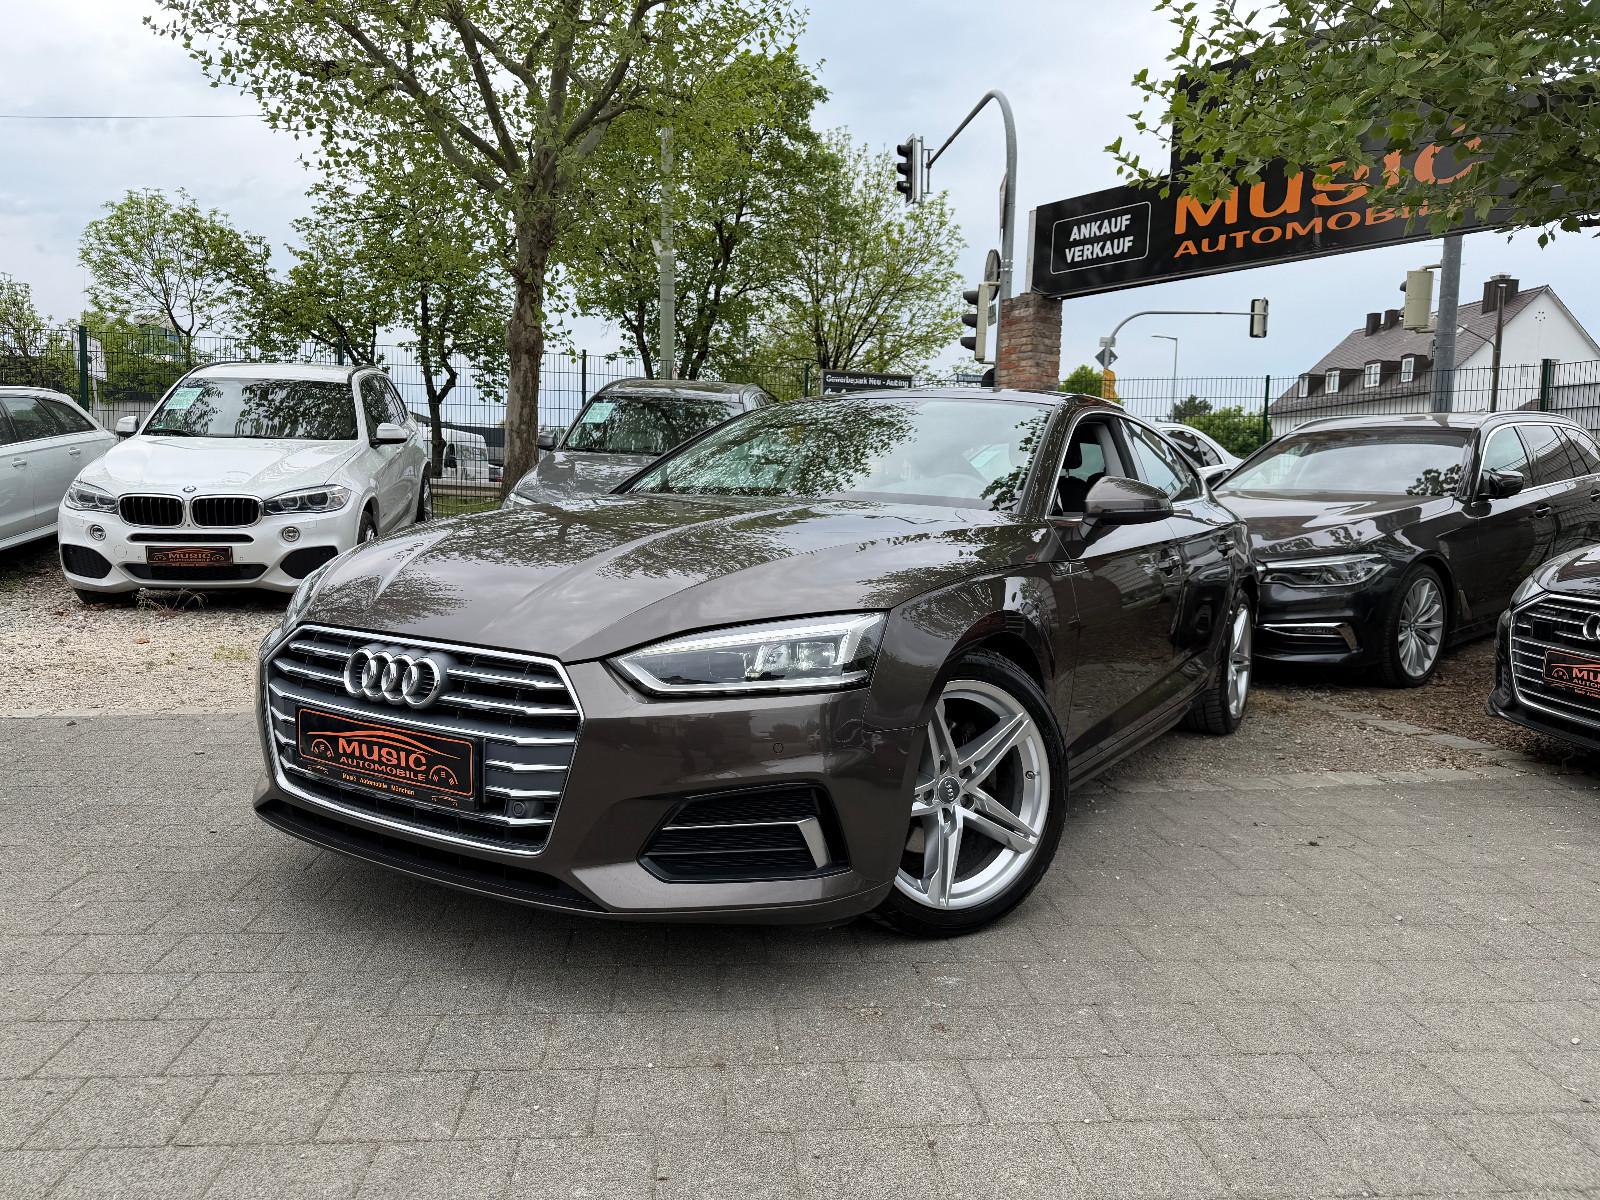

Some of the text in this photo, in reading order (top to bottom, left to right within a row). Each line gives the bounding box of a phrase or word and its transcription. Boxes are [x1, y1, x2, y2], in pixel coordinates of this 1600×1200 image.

[1069, 214, 1132, 242] ANKAUF
[1065, 236, 1134, 263] VERKAUF
[826, 374, 868, 386] Gewerbepark
[869, 377, 882, 386] Neu
[338, 738, 426, 771] MUSIC
[340, 756, 426, 781] AUTOMOBILE
